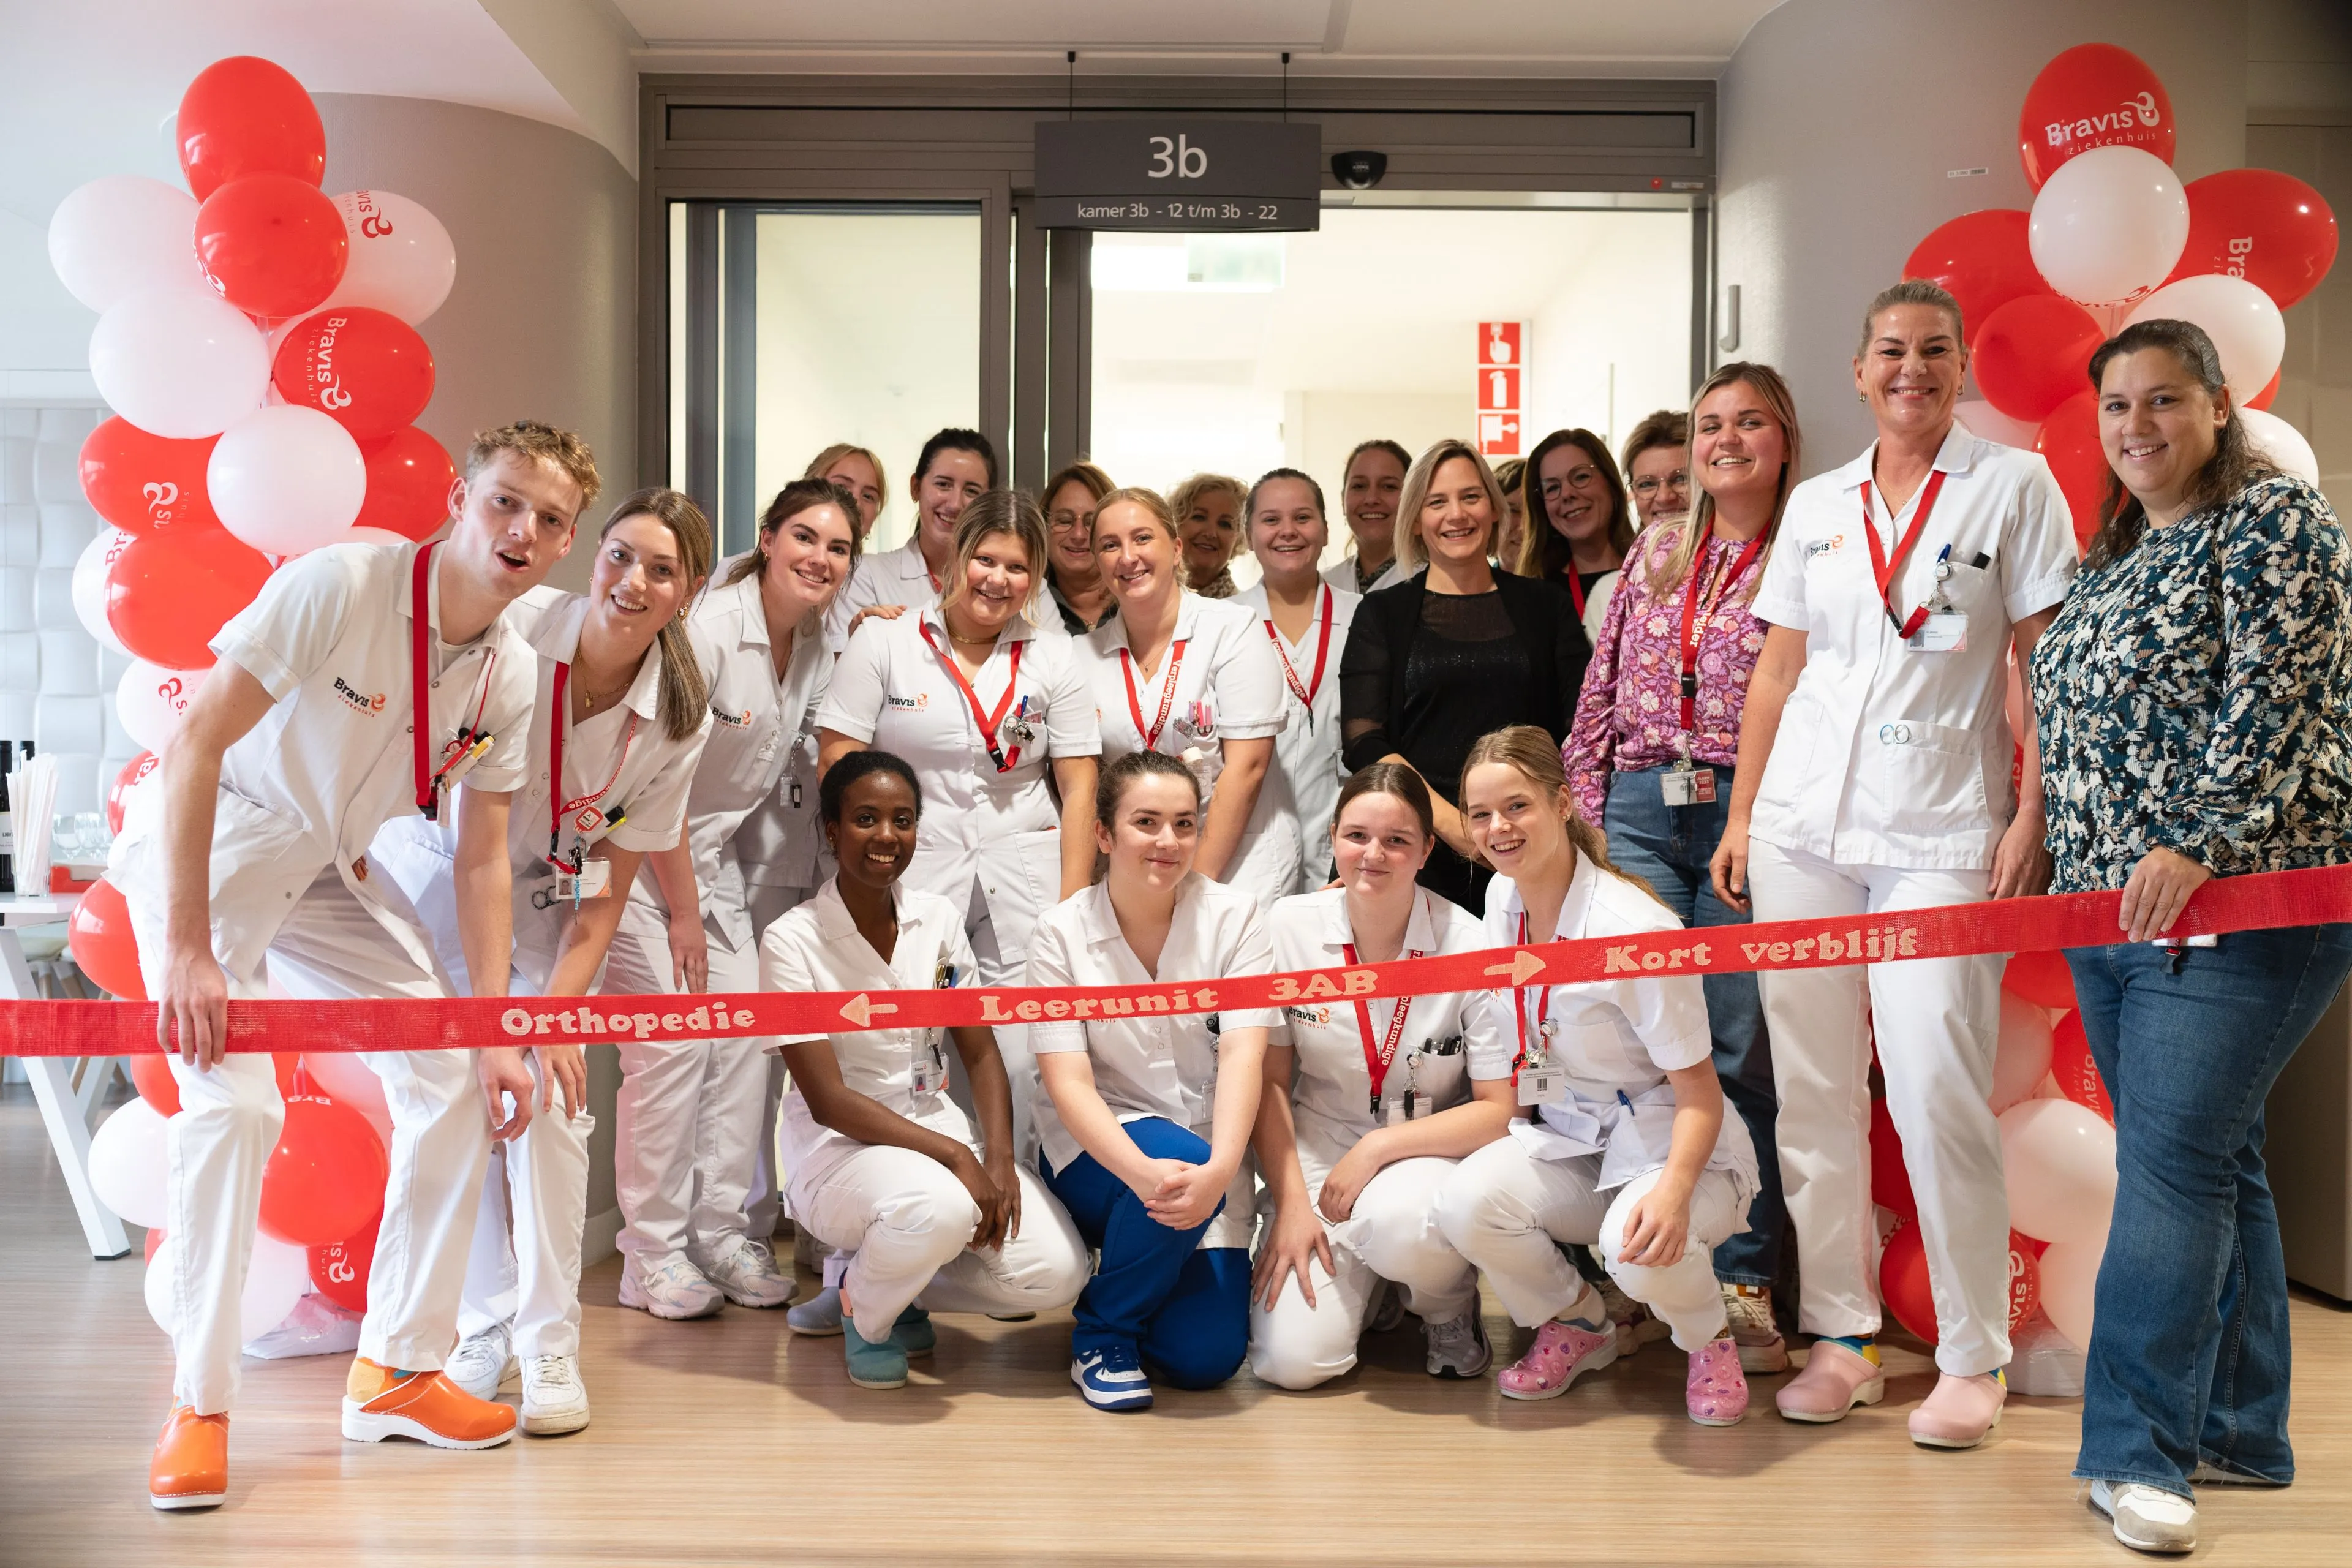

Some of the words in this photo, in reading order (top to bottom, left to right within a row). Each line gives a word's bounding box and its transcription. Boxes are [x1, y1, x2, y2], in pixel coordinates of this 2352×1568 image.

[2045, 111, 2133, 146] Bravis
[2068, 130, 2156, 155] ziekenhuis
[1148, 134, 1208, 178] 3b
[1077, 203, 1126, 218] kamer
[1129, 203, 1149, 218] 3b
[1167, 203, 1183, 217] 12
[1188, 205, 1216, 218] t/m
[1221, 204, 1241, 219] 3b
[1259, 205, 1278, 219] 22
[2227, 236, 2252, 279] Bra
[306, 328, 319, 403] ziekenhuis
[317, 318, 348, 382] Bravis
[334, 676, 369, 707] Bravis
[888, 695, 915, 706] Bravis
[1152, 659, 1182, 735] Verpleegkundige
[712, 706, 741, 725] Bravis
[501, 1001, 756, 1038] Orthopedie
[979, 987, 1219, 1021] Leerunit
[1268, 970, 1378, 1000] 3AB
[1604, 942, 1711, 973] Kort
[1741, 927, 1917, 963] verblijf
[1289, 1006, 1316, 1022] Bravis
[1382, 996, 1409, 1066] pleegkundige
[287, 1096, 332, 1105] Bra
